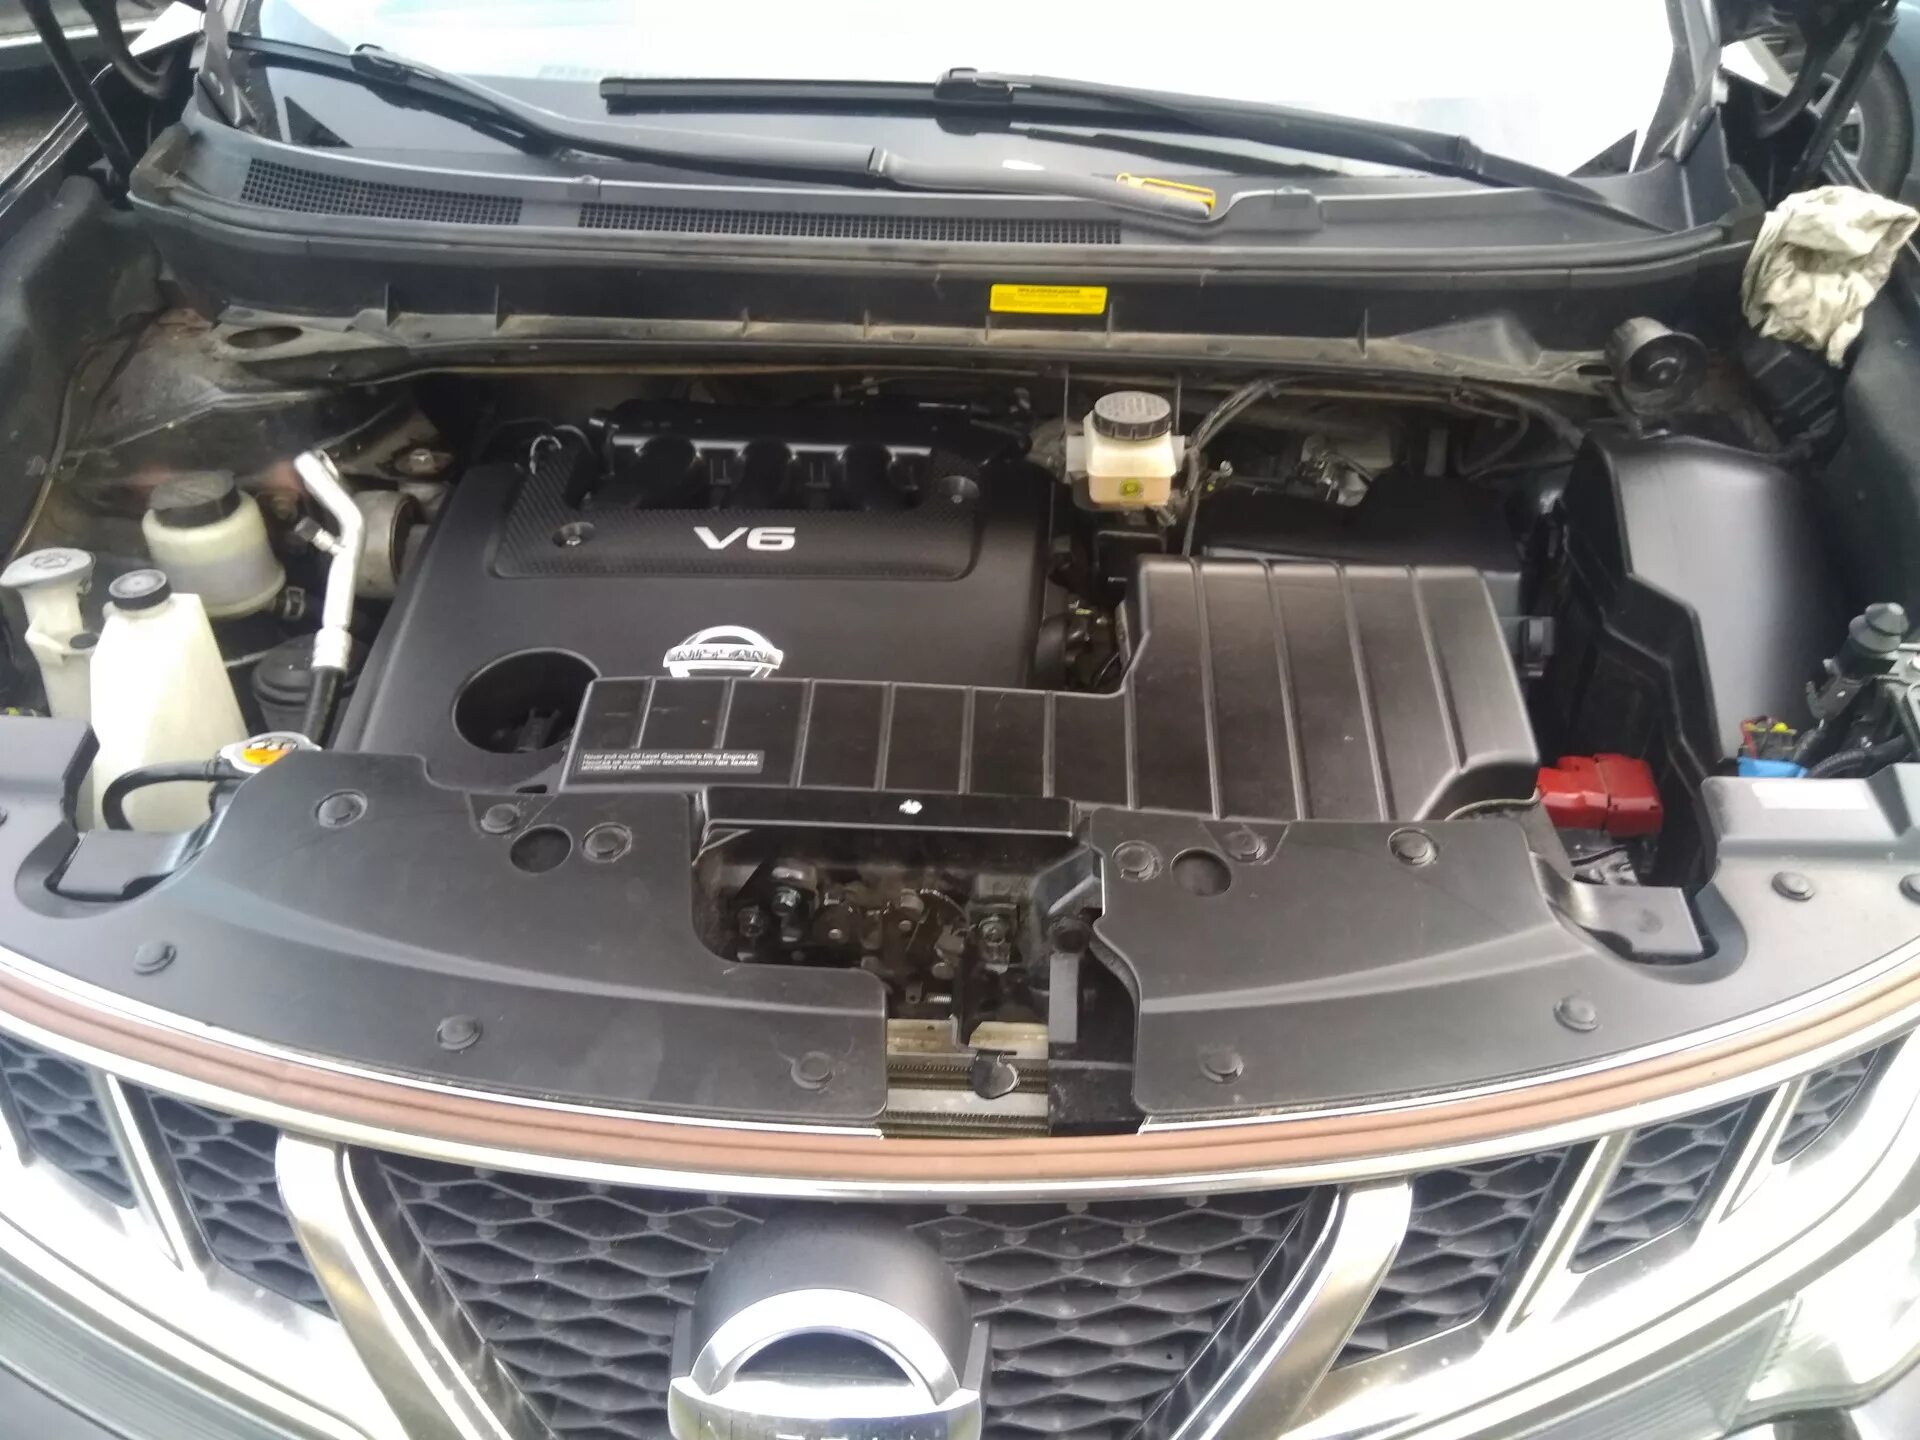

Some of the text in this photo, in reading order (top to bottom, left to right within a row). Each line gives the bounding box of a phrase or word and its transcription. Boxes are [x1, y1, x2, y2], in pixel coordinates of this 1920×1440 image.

[693, 526, 796, 551] V6
[674, 648, 769, 662] NISSAN
[642, 752, 660, 760] Level
